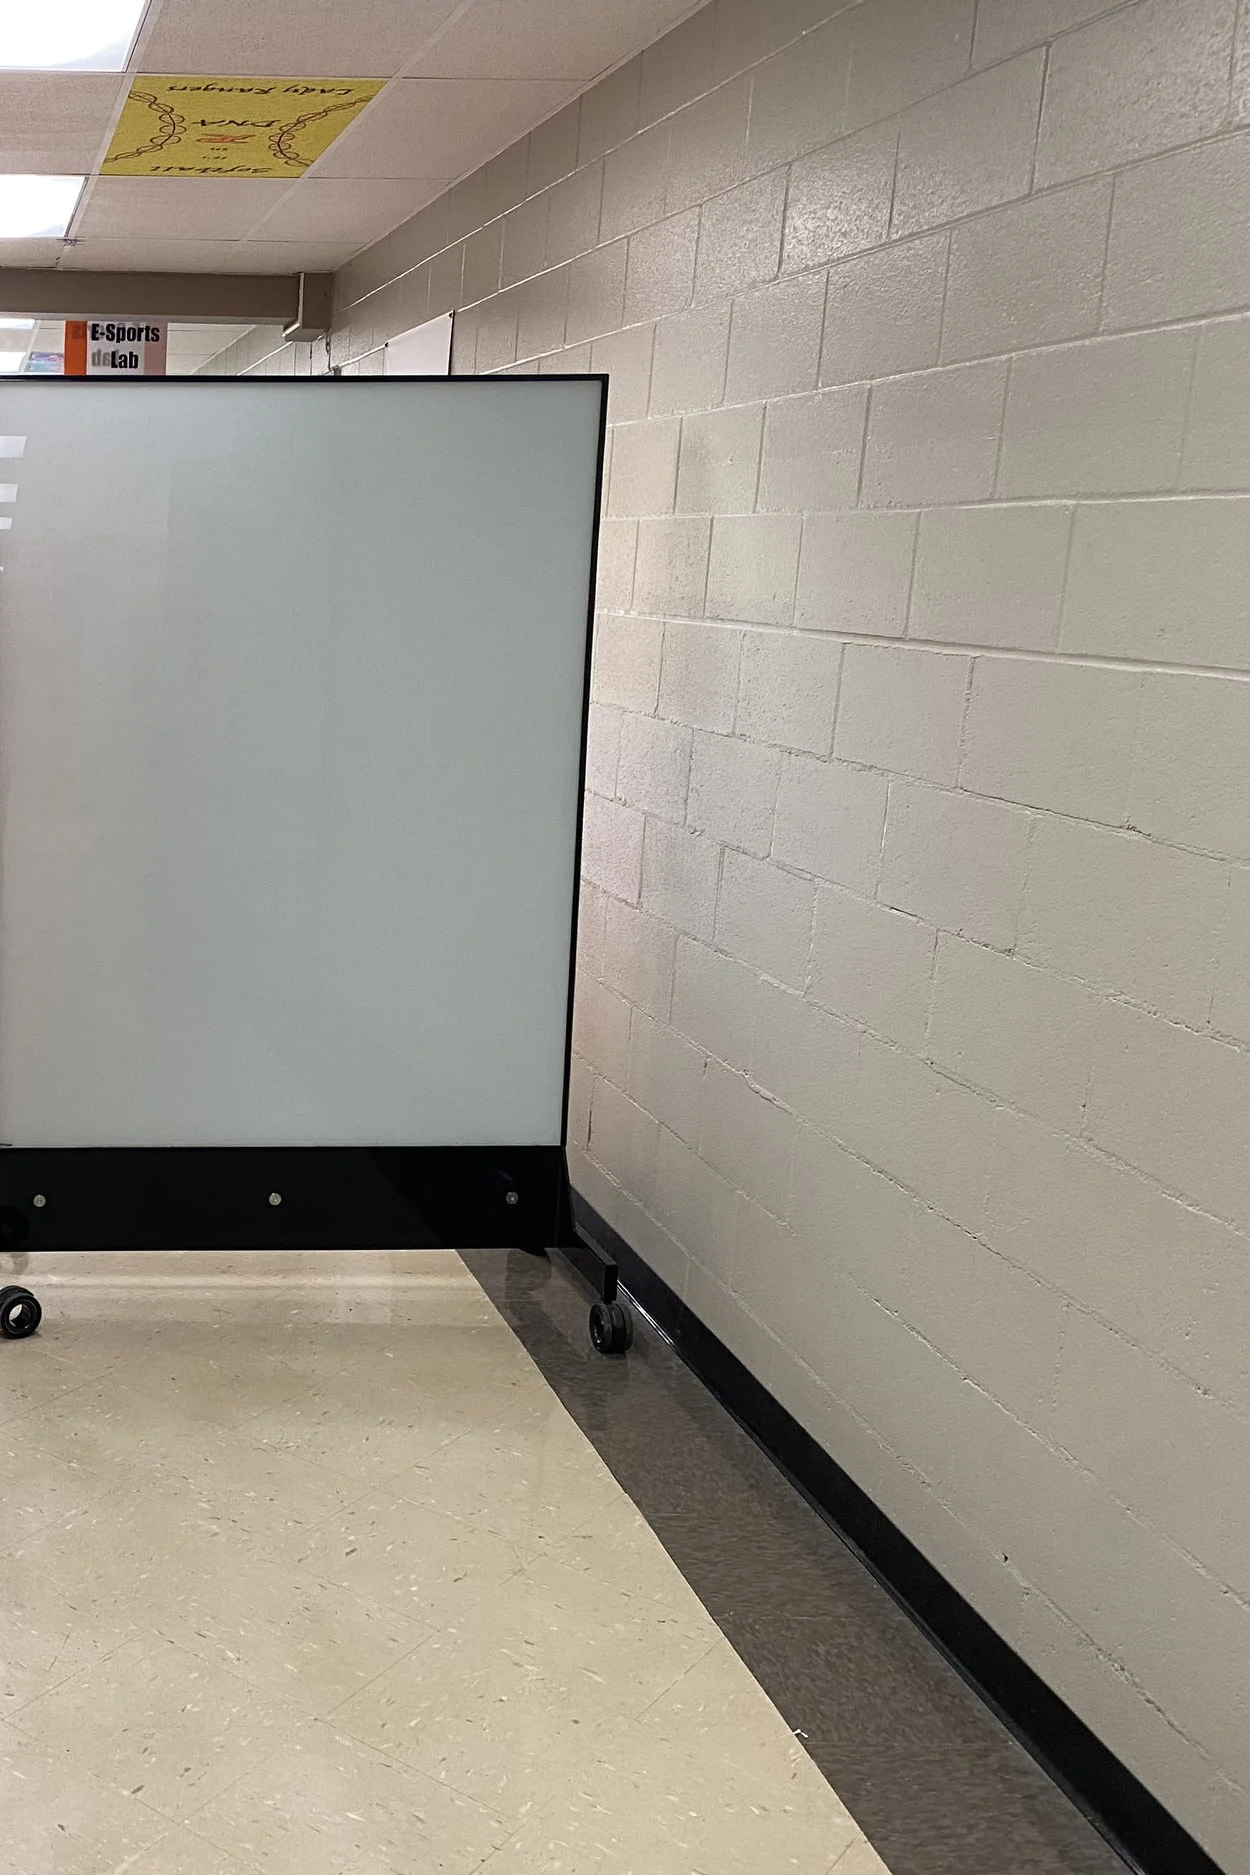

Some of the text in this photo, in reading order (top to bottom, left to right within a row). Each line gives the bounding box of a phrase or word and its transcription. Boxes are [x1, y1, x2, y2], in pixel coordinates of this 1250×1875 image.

[166, 83, 355, 96] Lady Rangers
[191, 118, 283, 128] DNA
[90, 323, 160, 343] E-Sports
[110, 350, 139, 369] Lab
